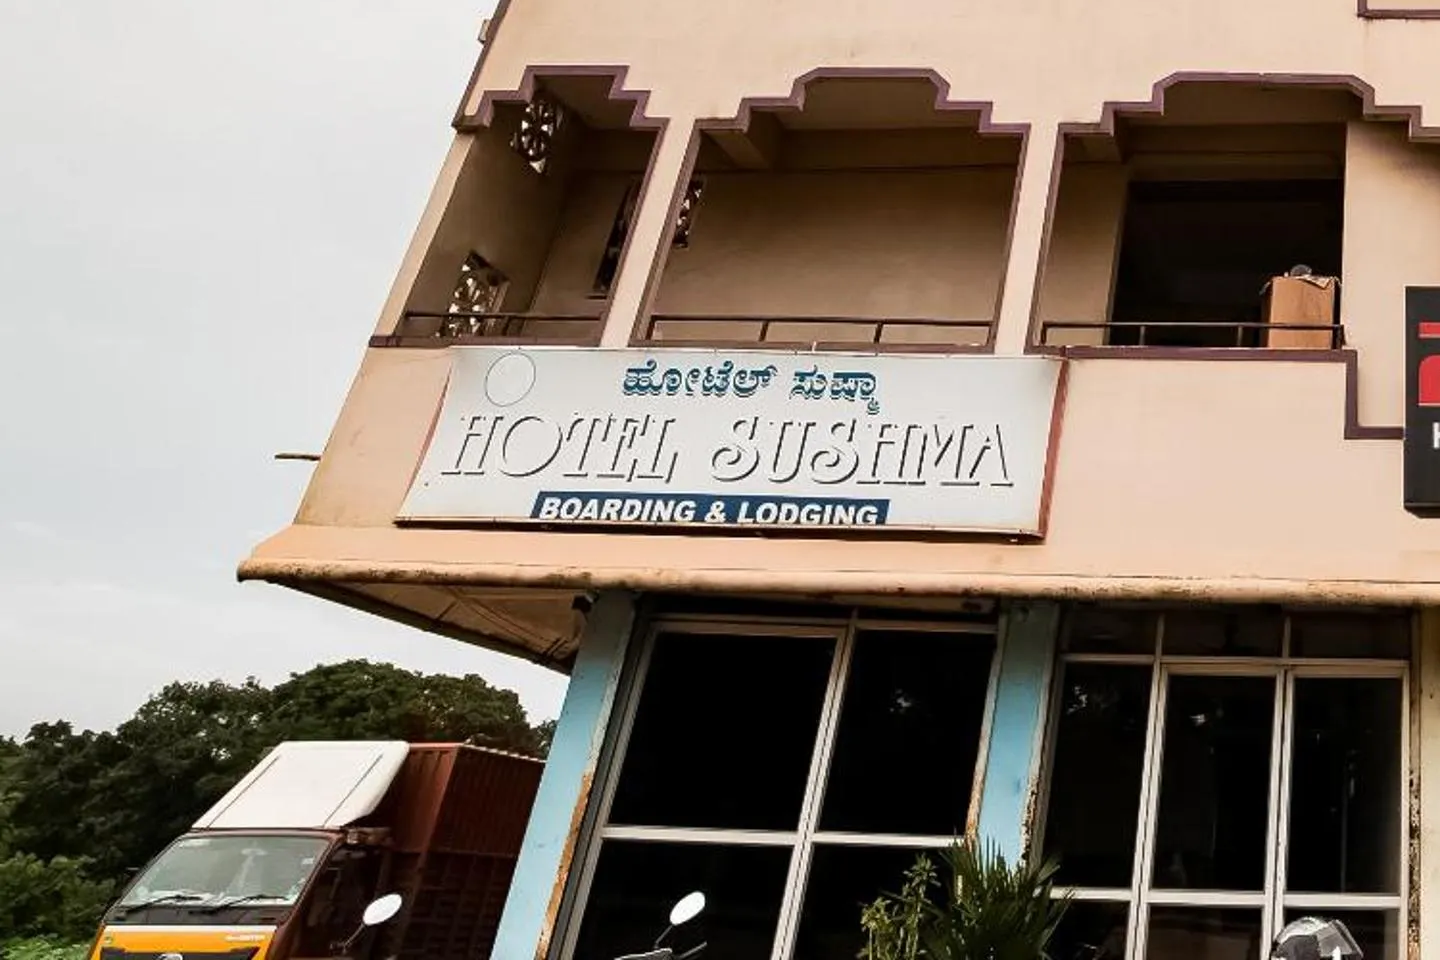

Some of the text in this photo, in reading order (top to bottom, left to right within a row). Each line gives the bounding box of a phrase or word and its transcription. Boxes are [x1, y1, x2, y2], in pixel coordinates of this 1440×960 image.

[622, 359, 881, 416] ಹೋಟೆಲ್ ಸುಷ್ಮಾ
[439, 413, 1015, 487] HOTEL SUSHMA
[537, 495, 880, 526] BOARDING & LODGING
